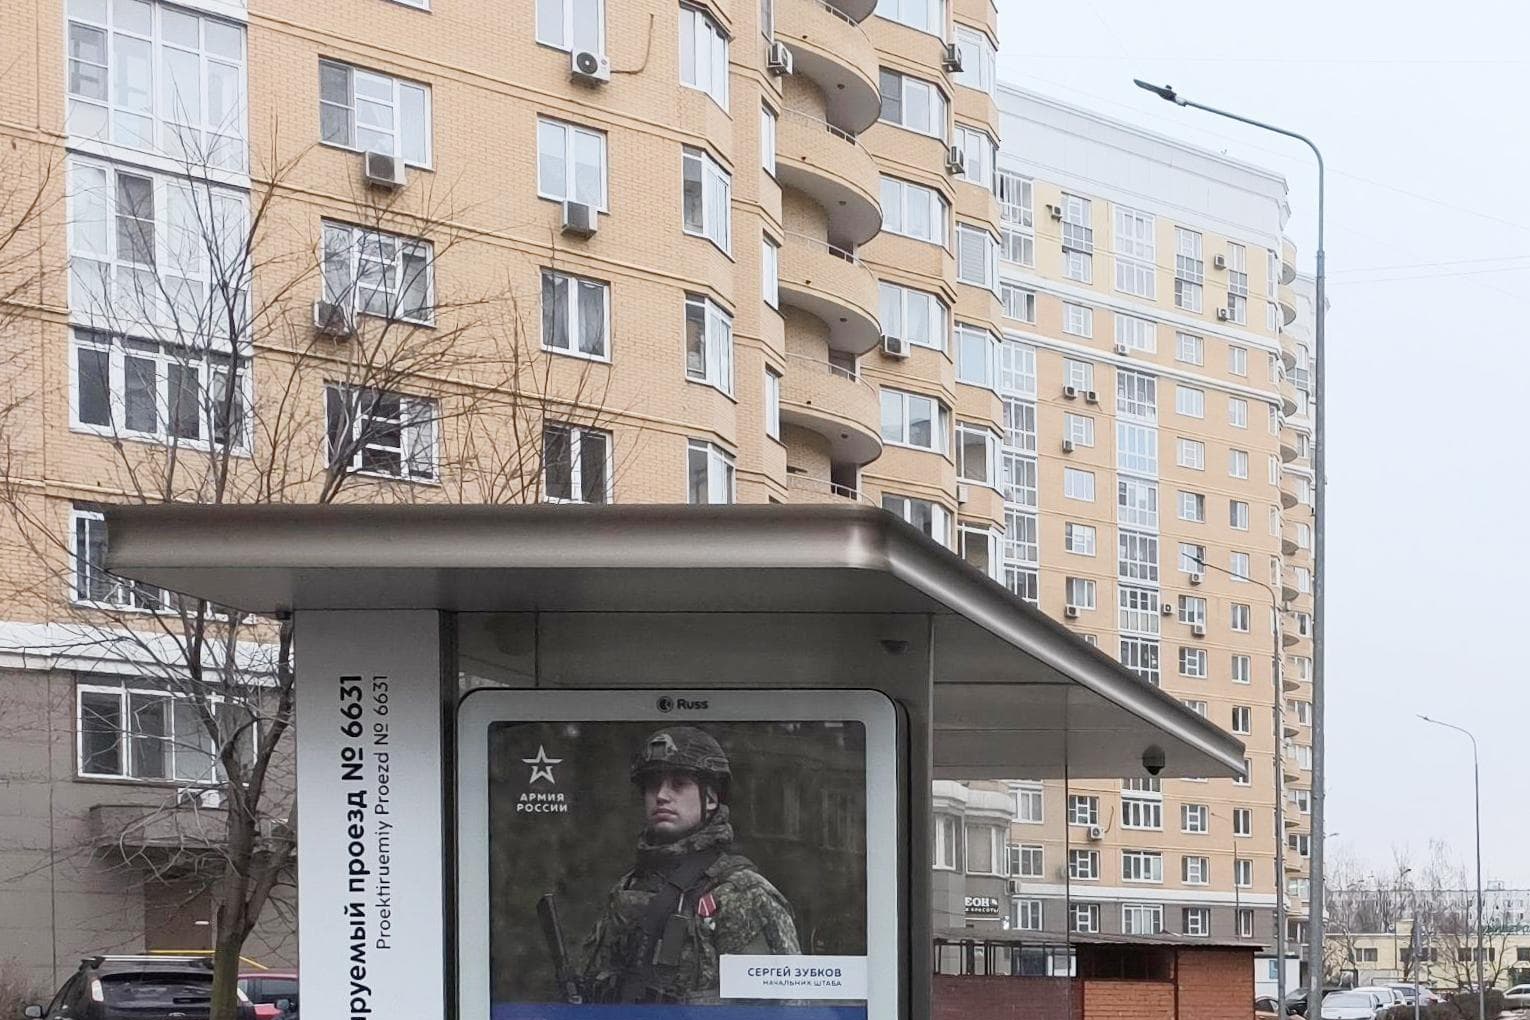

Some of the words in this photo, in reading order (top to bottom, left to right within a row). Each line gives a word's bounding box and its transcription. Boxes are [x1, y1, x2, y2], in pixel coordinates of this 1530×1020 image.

[340, 675, 363, 738] 6631
[372, 675, 388, 716] 6631
[676, 699, 709, 710] Russ
[373, 722, 388, 744] №
[341, 746, 363, 780] №
[374, 752, 390, 815] Proezd
[519, 793, 565, 802] АРМИЯ
[516, 803, 568, 813] РОССИИ
[347, 790, 370, 892] проезд
[374, 820, 393, 949] Proektiruemiy
[747, 966, 791, 977] СЕРГЕЙ
[794, 968, 842, 977] ЗУБКОВ
